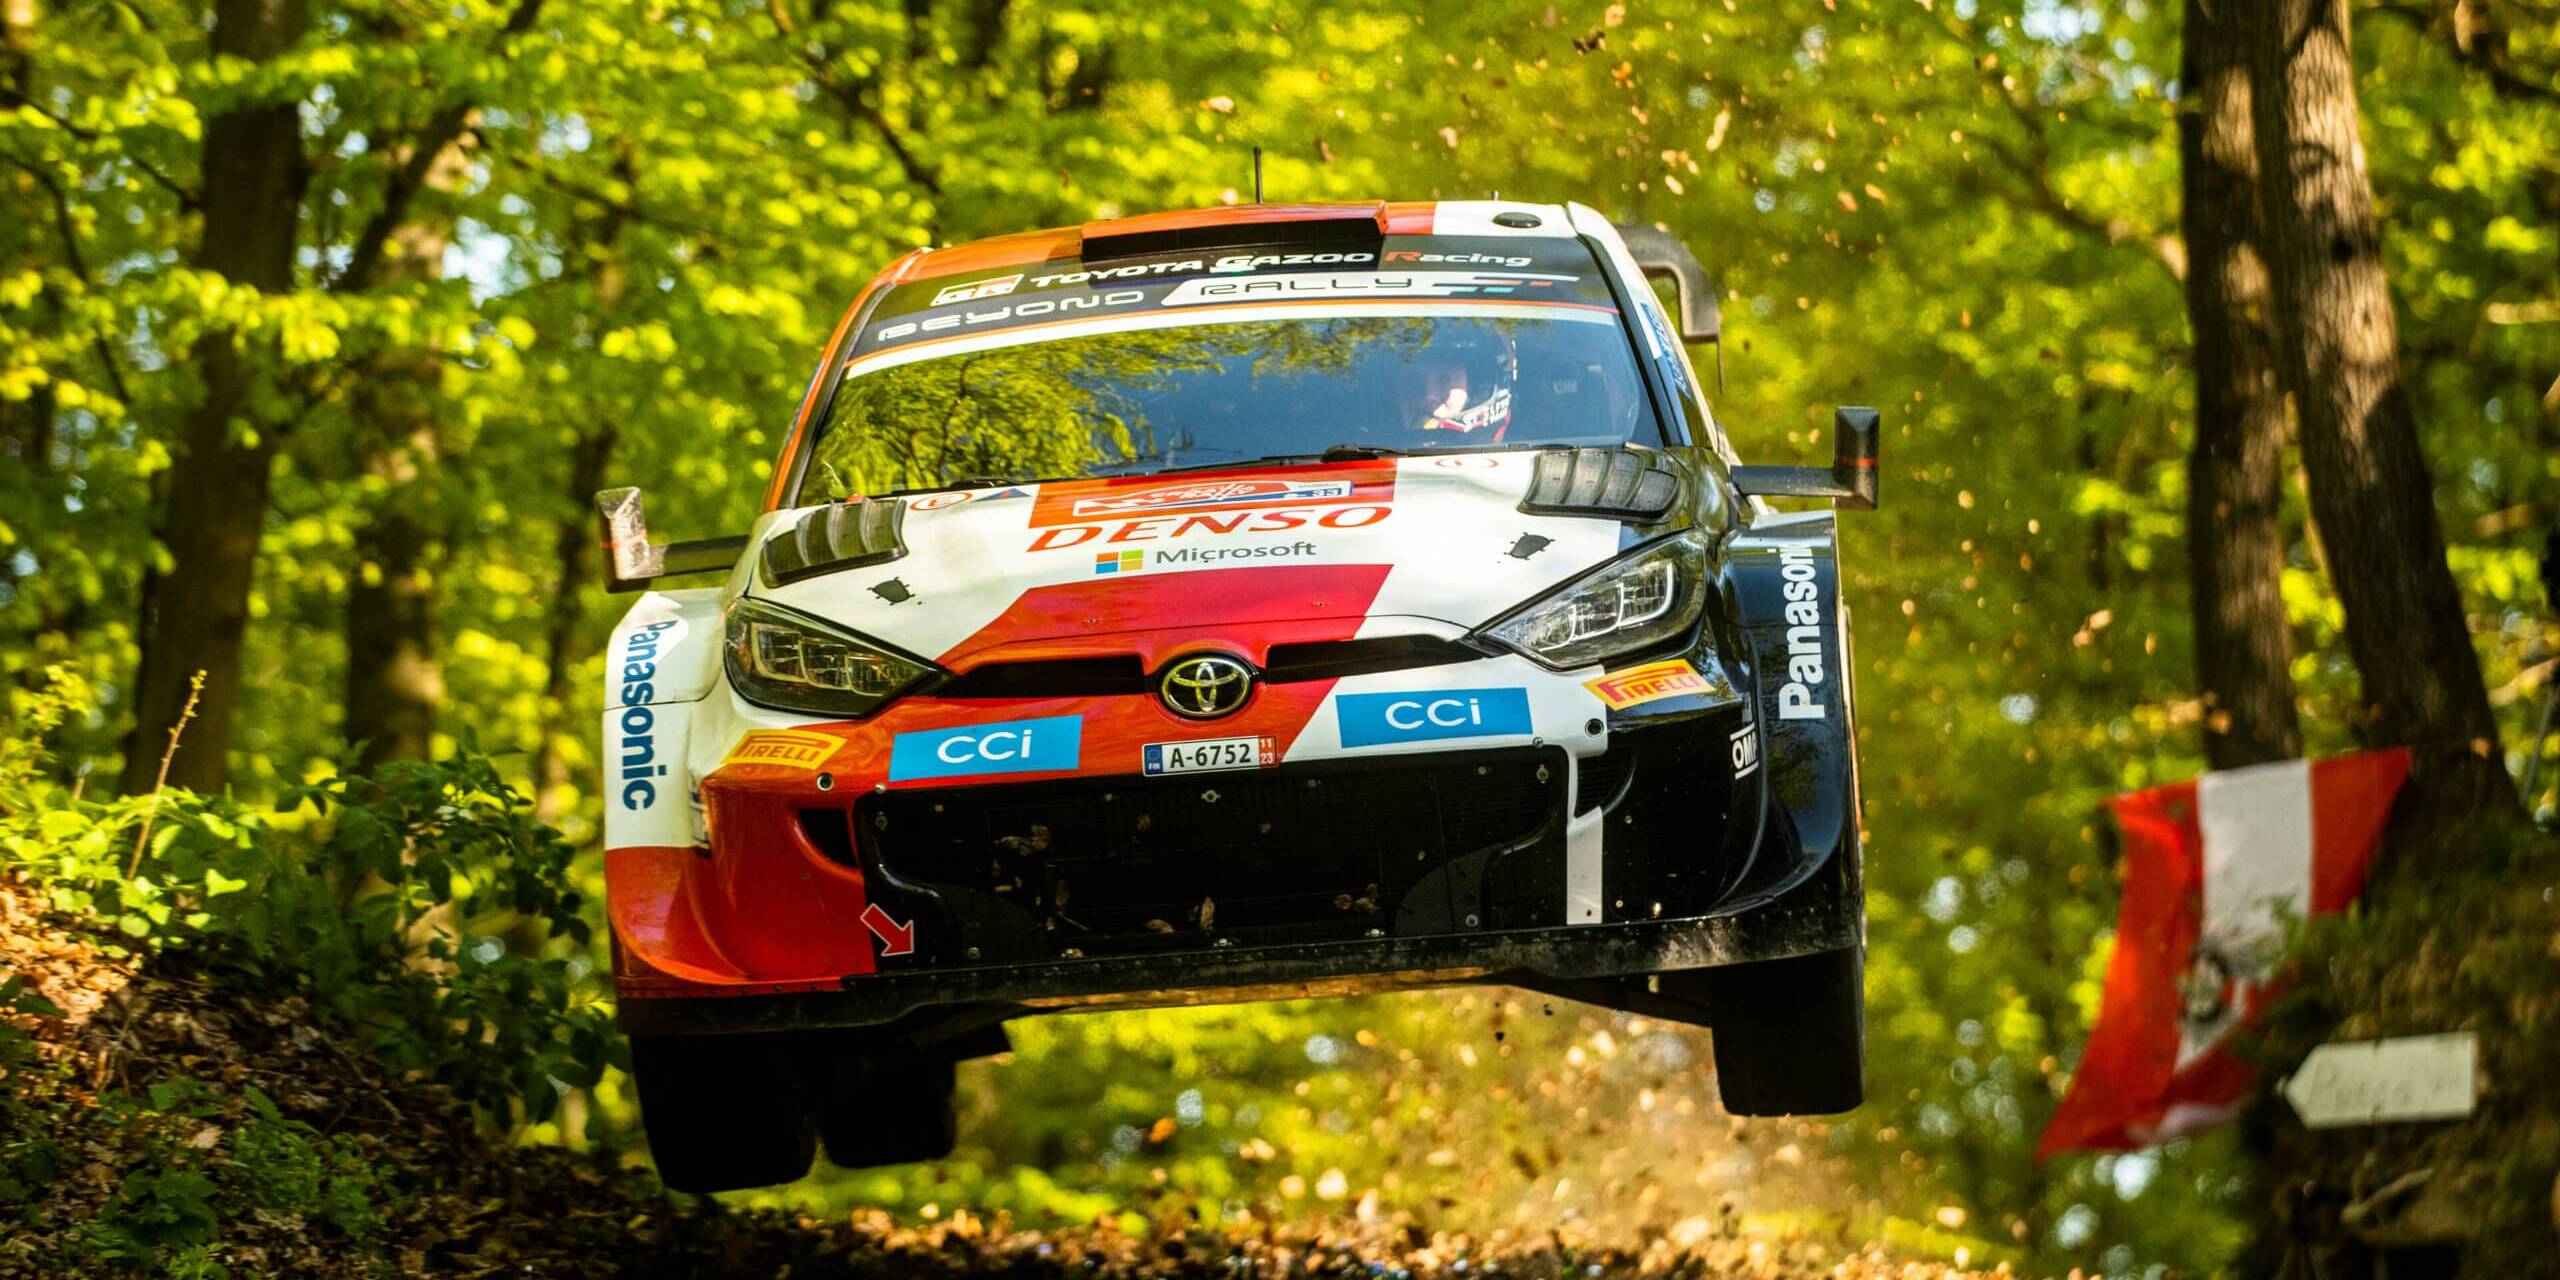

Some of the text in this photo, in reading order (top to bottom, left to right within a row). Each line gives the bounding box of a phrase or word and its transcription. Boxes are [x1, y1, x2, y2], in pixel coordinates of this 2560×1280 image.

[1030, 260, 1203, 288] TOYOTA
[1212, 253, 1375, 270] GAZOO
[1384, 251, 1533, 267] Racing
[878, 278, 1412, 342] BEYOND RALLY
[1025, 507, 1393, 552] DENSO
[1156, 541, 1316, 563] Microsoft
[1767, 543, 1825, 720] Panasoni
[1597, 665, 1700, 703] PIRELLI
[621, 620, 678, 810] Panasonic
[734, 735, 832, 762] PIRELLI
[1170, 744, 1251, 768] A-6752
[1260, 738, 1273, 748] 11
[1260, 752, 1274, 764] 23
[1731, 728, 1758, 772] OMP
